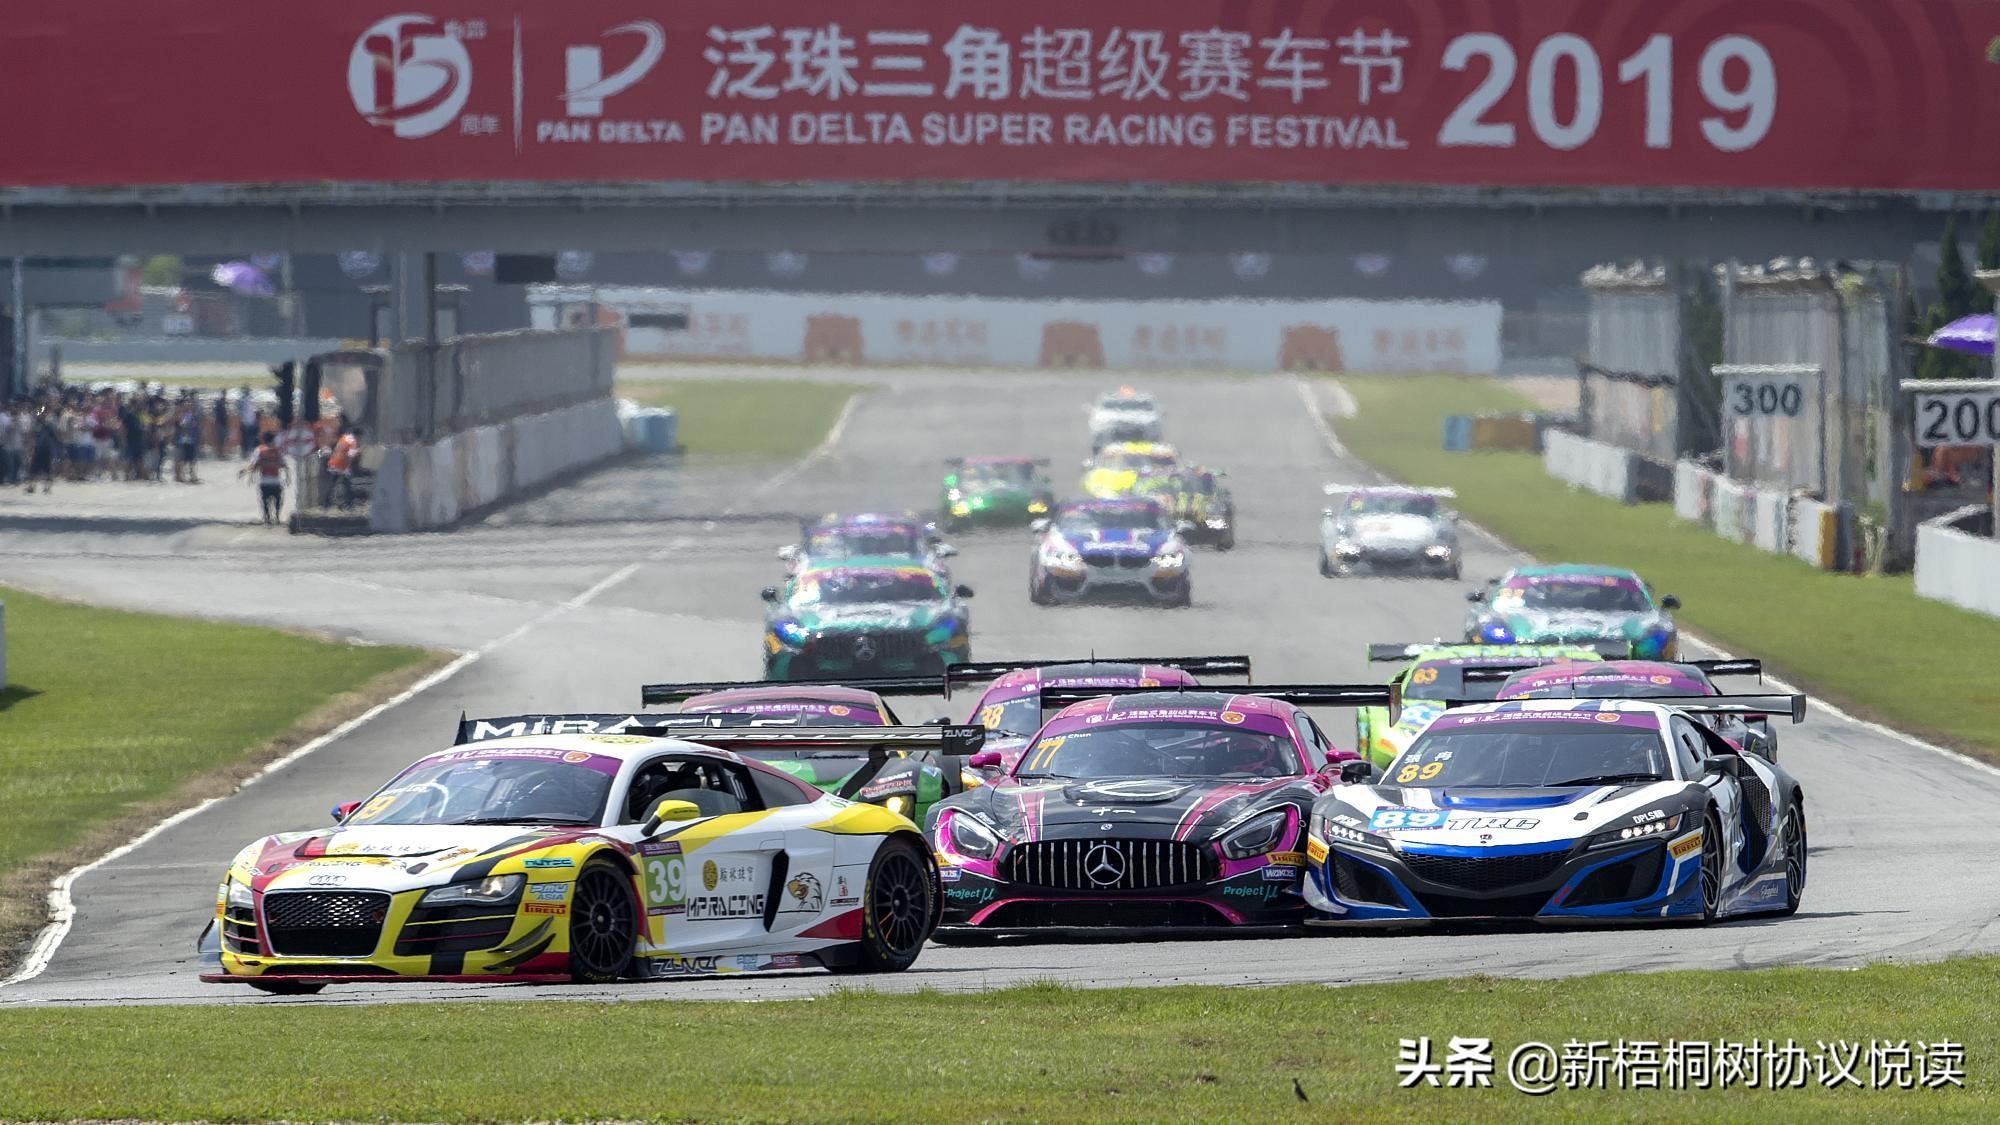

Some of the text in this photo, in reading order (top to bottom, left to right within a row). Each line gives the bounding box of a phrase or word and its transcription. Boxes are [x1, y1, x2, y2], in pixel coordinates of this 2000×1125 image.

[704, 24, 1408, 101] 泛珠三角超级赛车节
[1437, 33, 1777, 152] 2019
[536, 120, 684, 144] PAN DELTA
[702, 113, 1409, 148] PAN DELTA SUPER RACING FESTIVAL
[1733, 382, 1801, 417] 300
[1028, 739, 1065, 771] 77
[1396, 762, 1443, 783] 89
[1373, 810, 1440, 828] 89
[1448, 817, 1541, 830] TRC
[648, 859, 687, 903] 39
[1223, 885, 1264, 898] Project
[524, 902, 566, 915] PIRELLI
